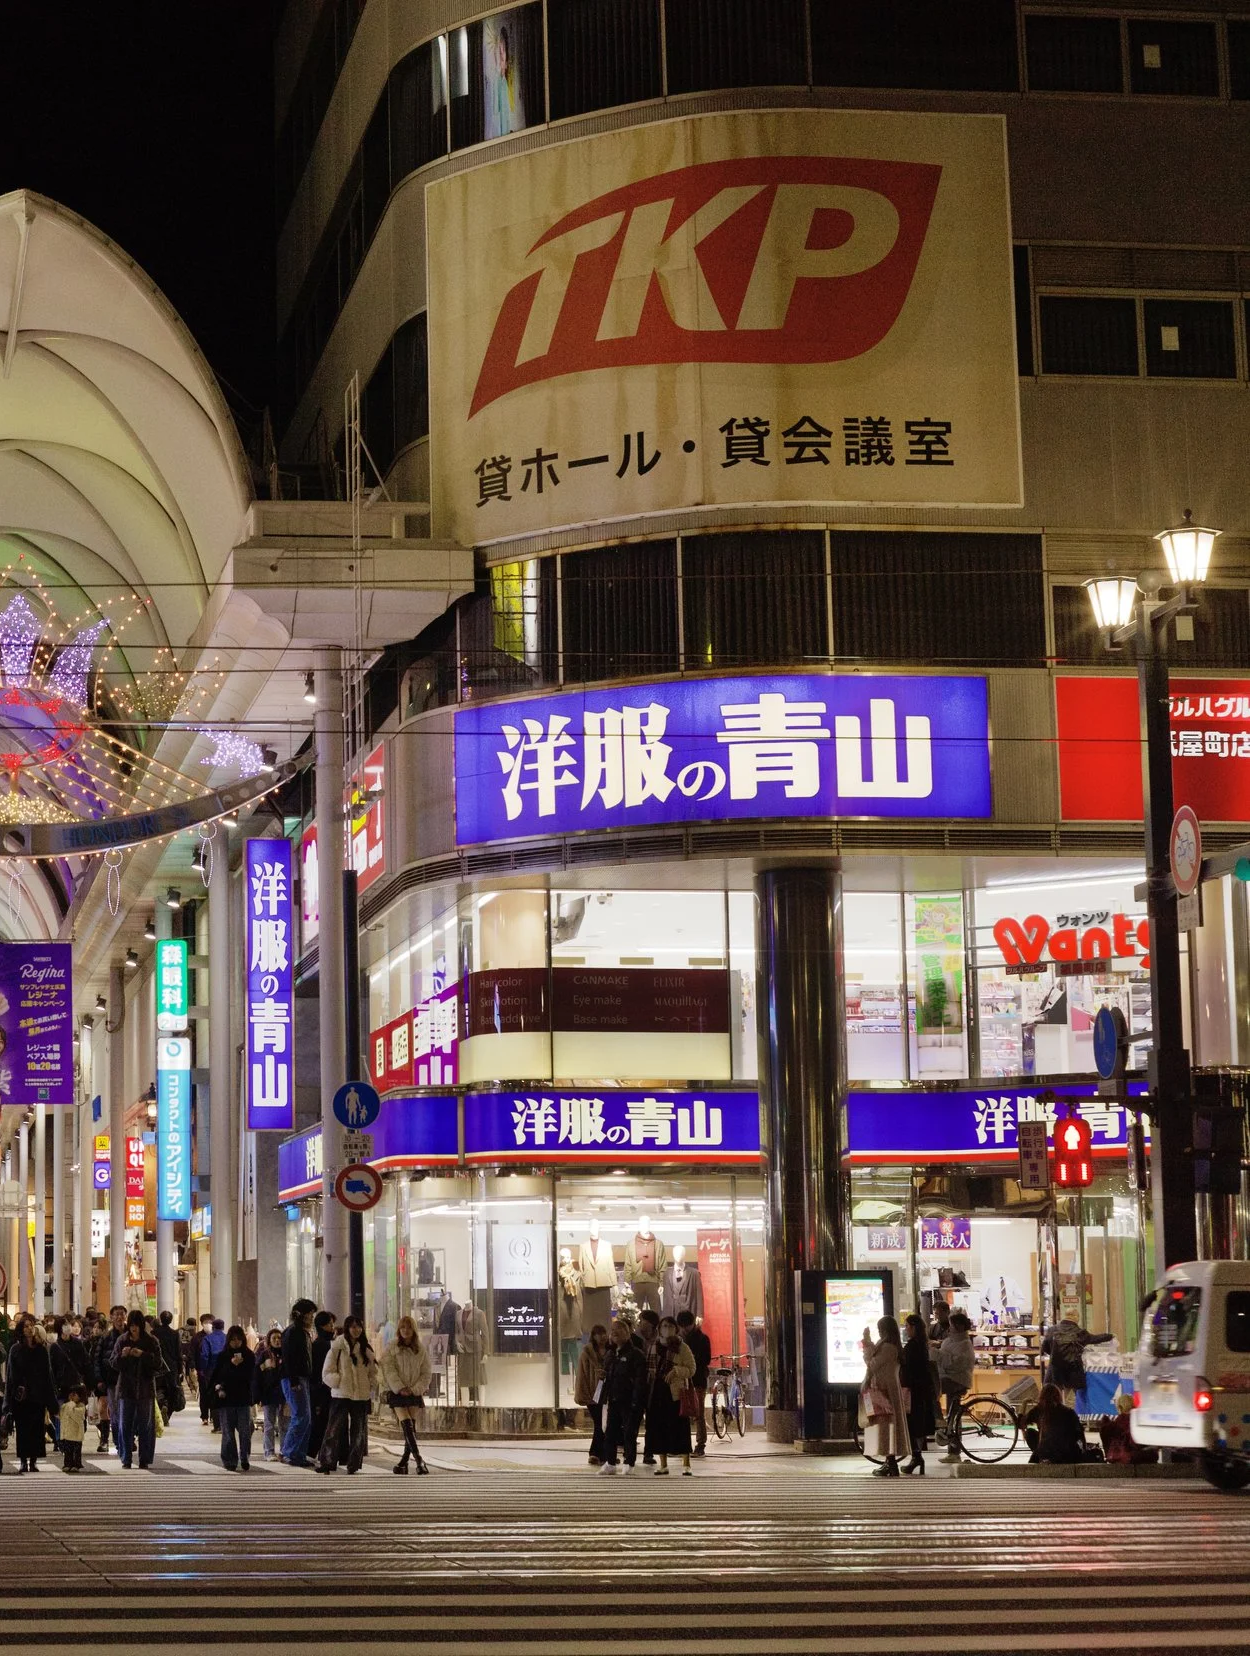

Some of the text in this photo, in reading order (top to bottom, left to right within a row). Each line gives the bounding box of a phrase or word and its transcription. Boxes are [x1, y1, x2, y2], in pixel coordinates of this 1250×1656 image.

[515, 183, 901, 369] TKP
[474, 415, 955, 508] 貸ホール・貸会議室
[496, 692, 934, 821] 洋服の青山
[1056, 911, 1109, 928] ウォンツ
[19, 963, 66, 983] Regina
[161, 944, 182, 1009] 森眼科
[573, 975, 630, 986] CANMAKE
[249, 861, 289, 1108] 洋服の青山
[498, 976, 523, 988] color
[28, 991, 58, 999] レジーナ
[500, 995, 528, 1007] otion
[573, 995, 622, 1007] Eye make
[573, 1014, 628, 1025] Base make
[510, 1097, 723, 1146] 洋服の青山
[166, 1074, 183, 1214] コンタクトのアイシティ
[699, 1238, 739, 1251] バーゲ
[870, 1232, 906, 1249] 新成
[924, 1232, 970, 1249] 新成人
[507, 1306, 535, 1314] オーダー
